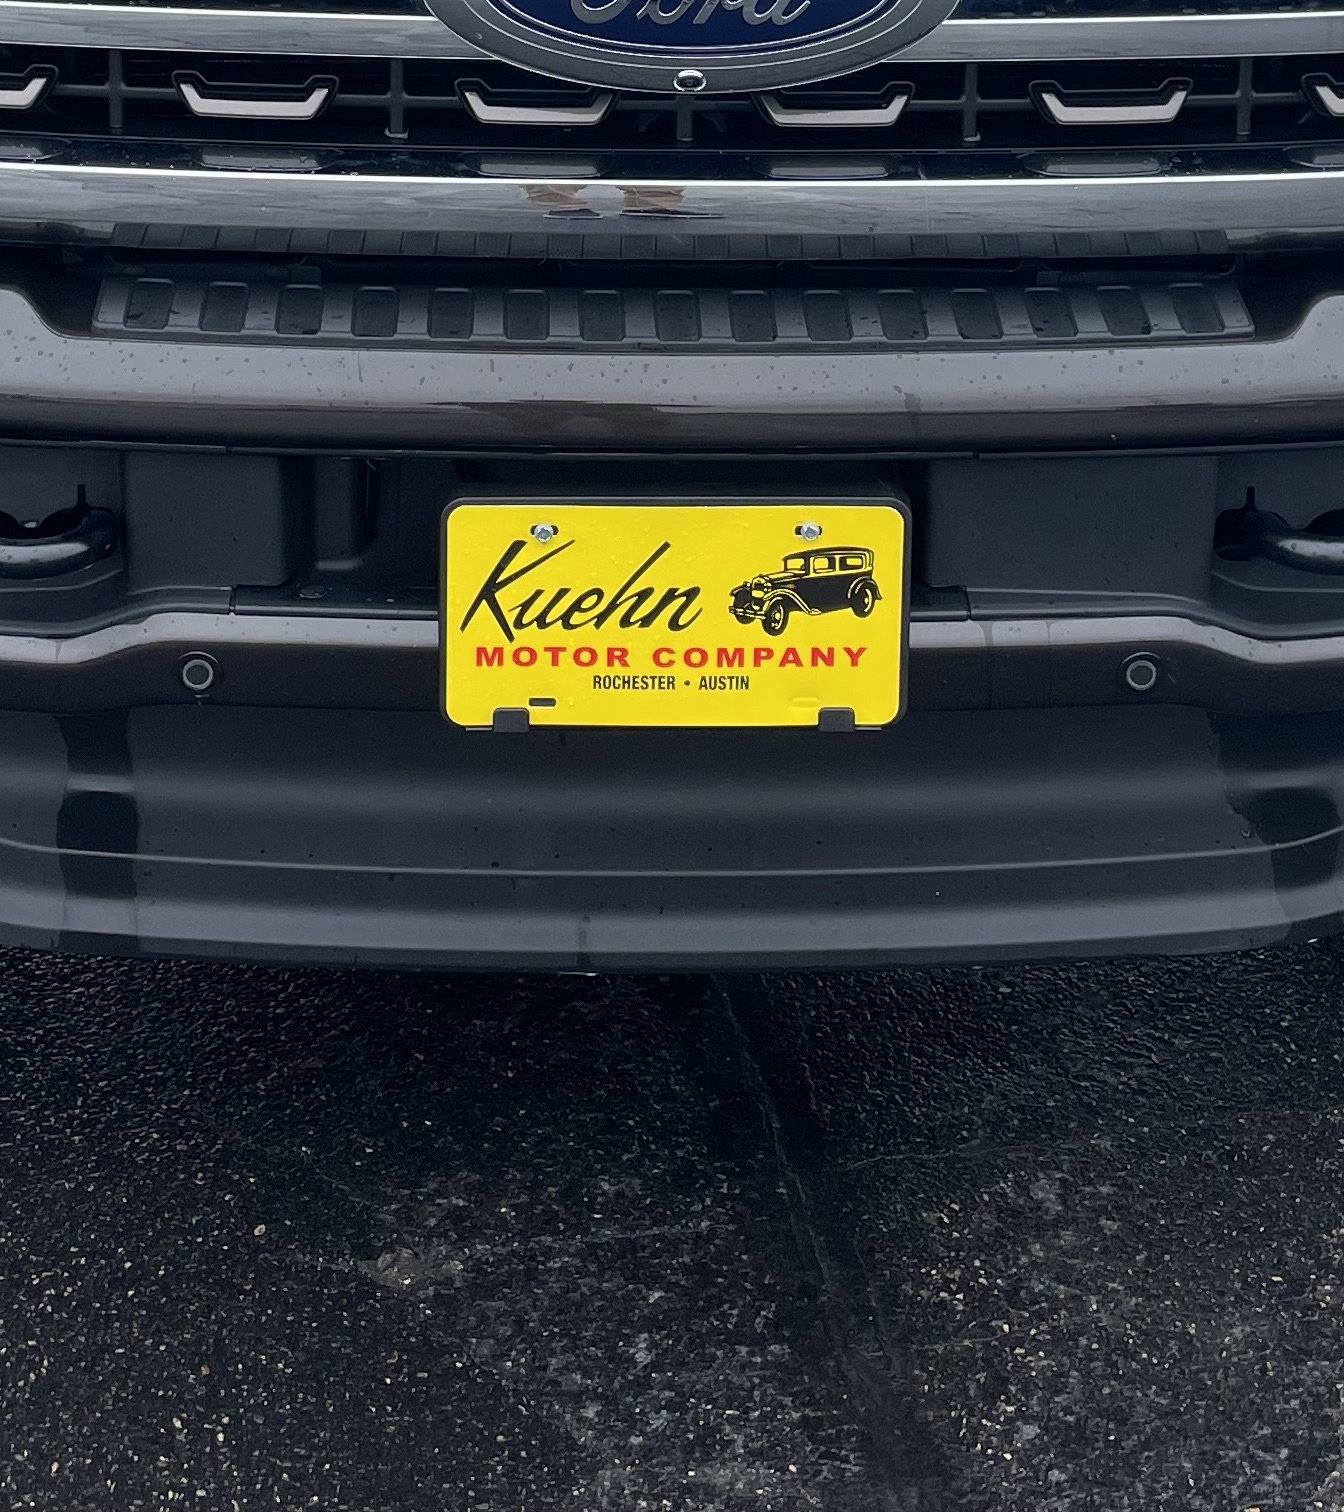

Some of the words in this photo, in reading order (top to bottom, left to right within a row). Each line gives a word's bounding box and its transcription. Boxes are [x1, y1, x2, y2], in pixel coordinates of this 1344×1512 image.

[459, 538, 704, 643] Kuehn
[475, 645, 630, 668] MOTOR
[652, 645, 869, 669] COMPANY
[592, 674, 676, 691] ROCHESTER
[698, 674, 750, 691] AUSTIN
